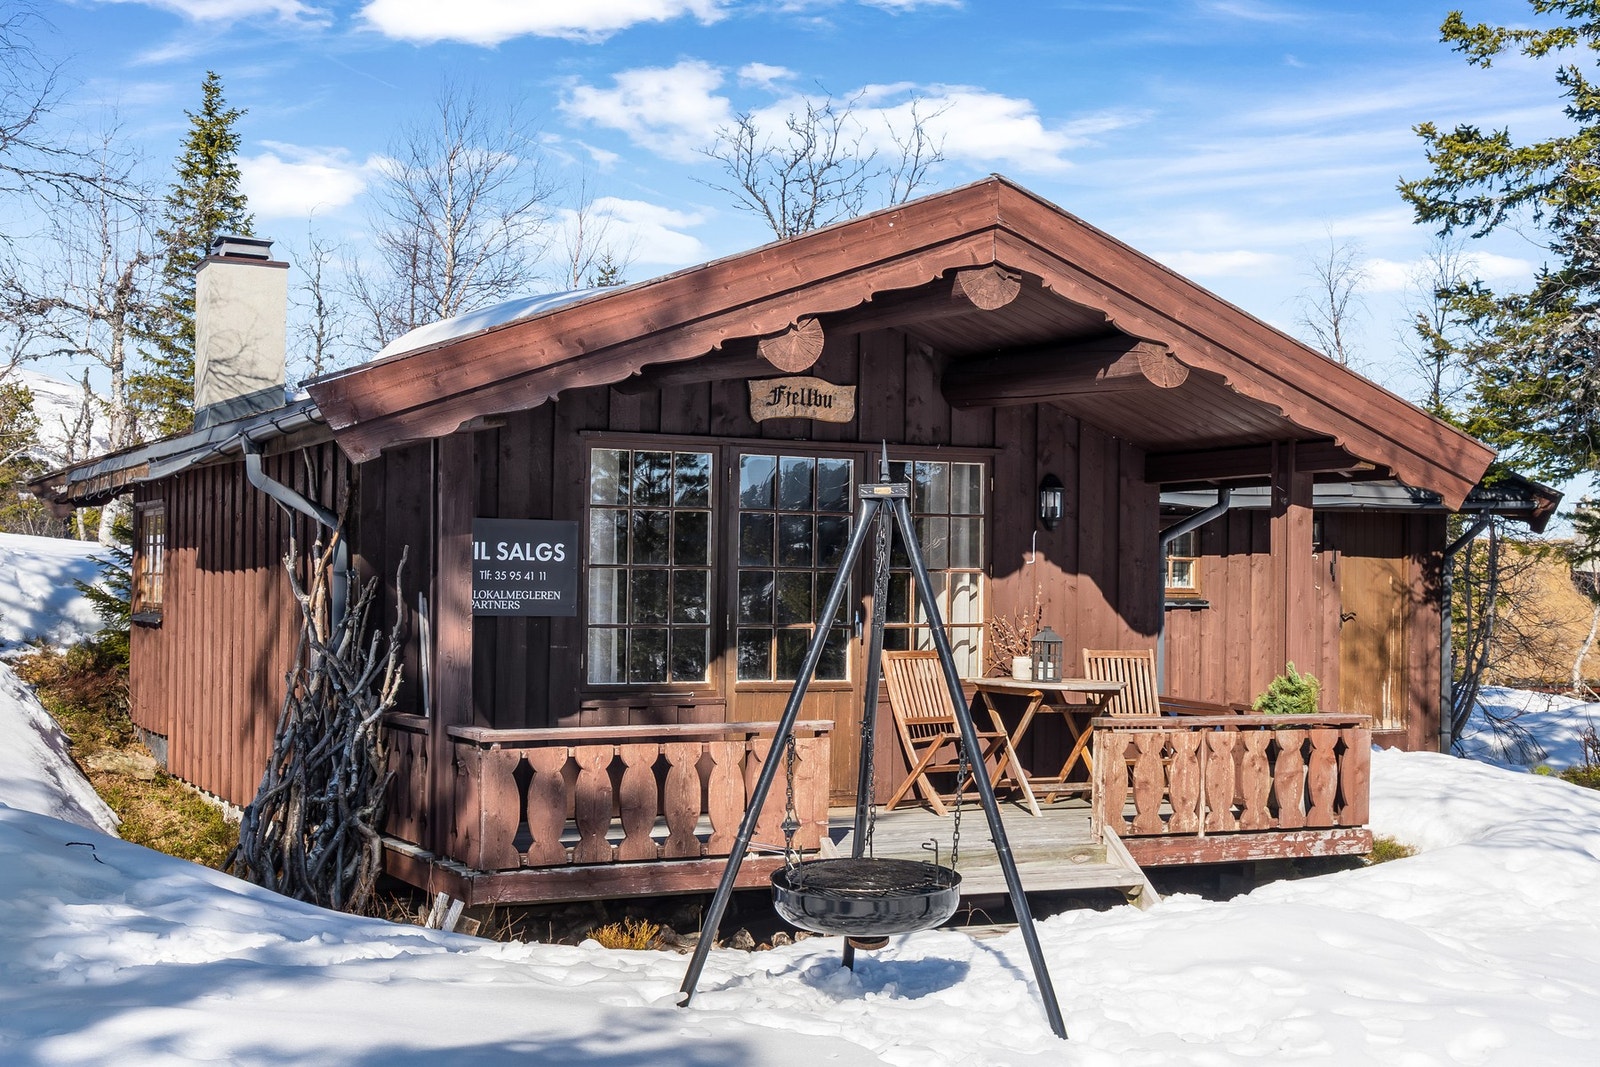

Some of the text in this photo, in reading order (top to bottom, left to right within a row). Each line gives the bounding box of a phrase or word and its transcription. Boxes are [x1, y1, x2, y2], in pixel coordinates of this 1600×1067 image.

[766, 385, 833, 409] Fjellbu
[472, 541, 566, 562] IL SALGS
[494, 571, 507, 581] 35
[509, 571, 521, 581] 95
[524, 571, 534, 581] 41
[539, 571, 547, 581] 11
[473, 590, 561, 600] LOKALMEGLEREN
